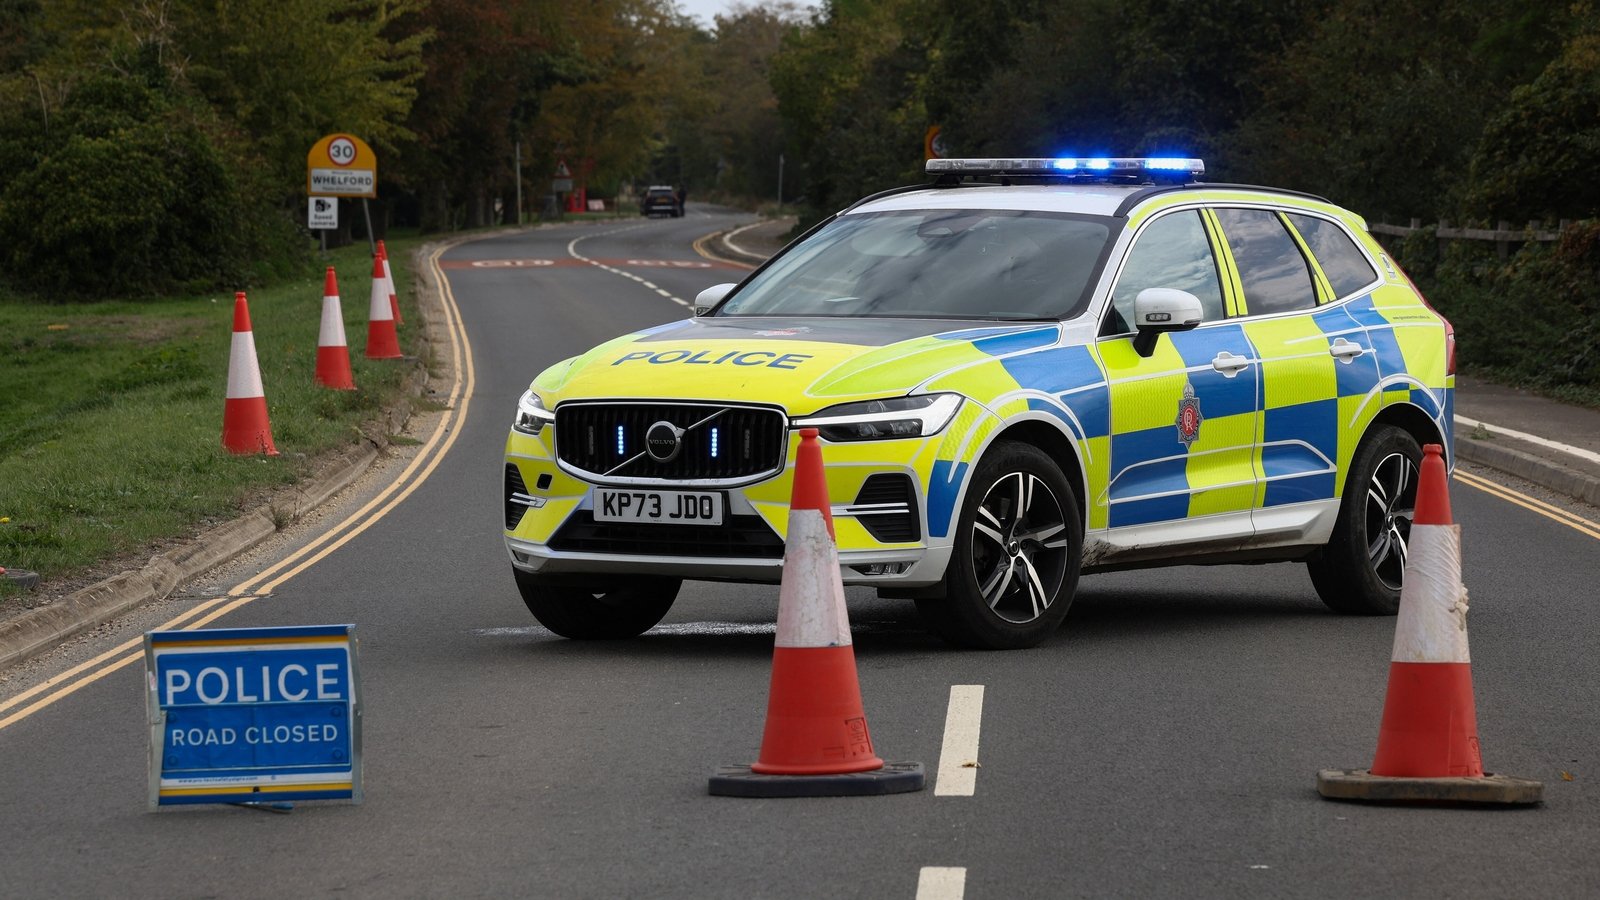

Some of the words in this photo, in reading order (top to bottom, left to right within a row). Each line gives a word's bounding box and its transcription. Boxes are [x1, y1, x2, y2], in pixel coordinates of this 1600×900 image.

[331, 145, 353, 158] 30
[312, 175, 372, 186] WHELFORD
[611, 350, 814, 370] POLICE
[603, 492, 662, 518] KP73
[669, 494, 713, 520] JDO
[165, 663, 341, 705] POLICE
[172, 727, 236, 746] ROAD
[245, 724, 338, 744] CLOSED
